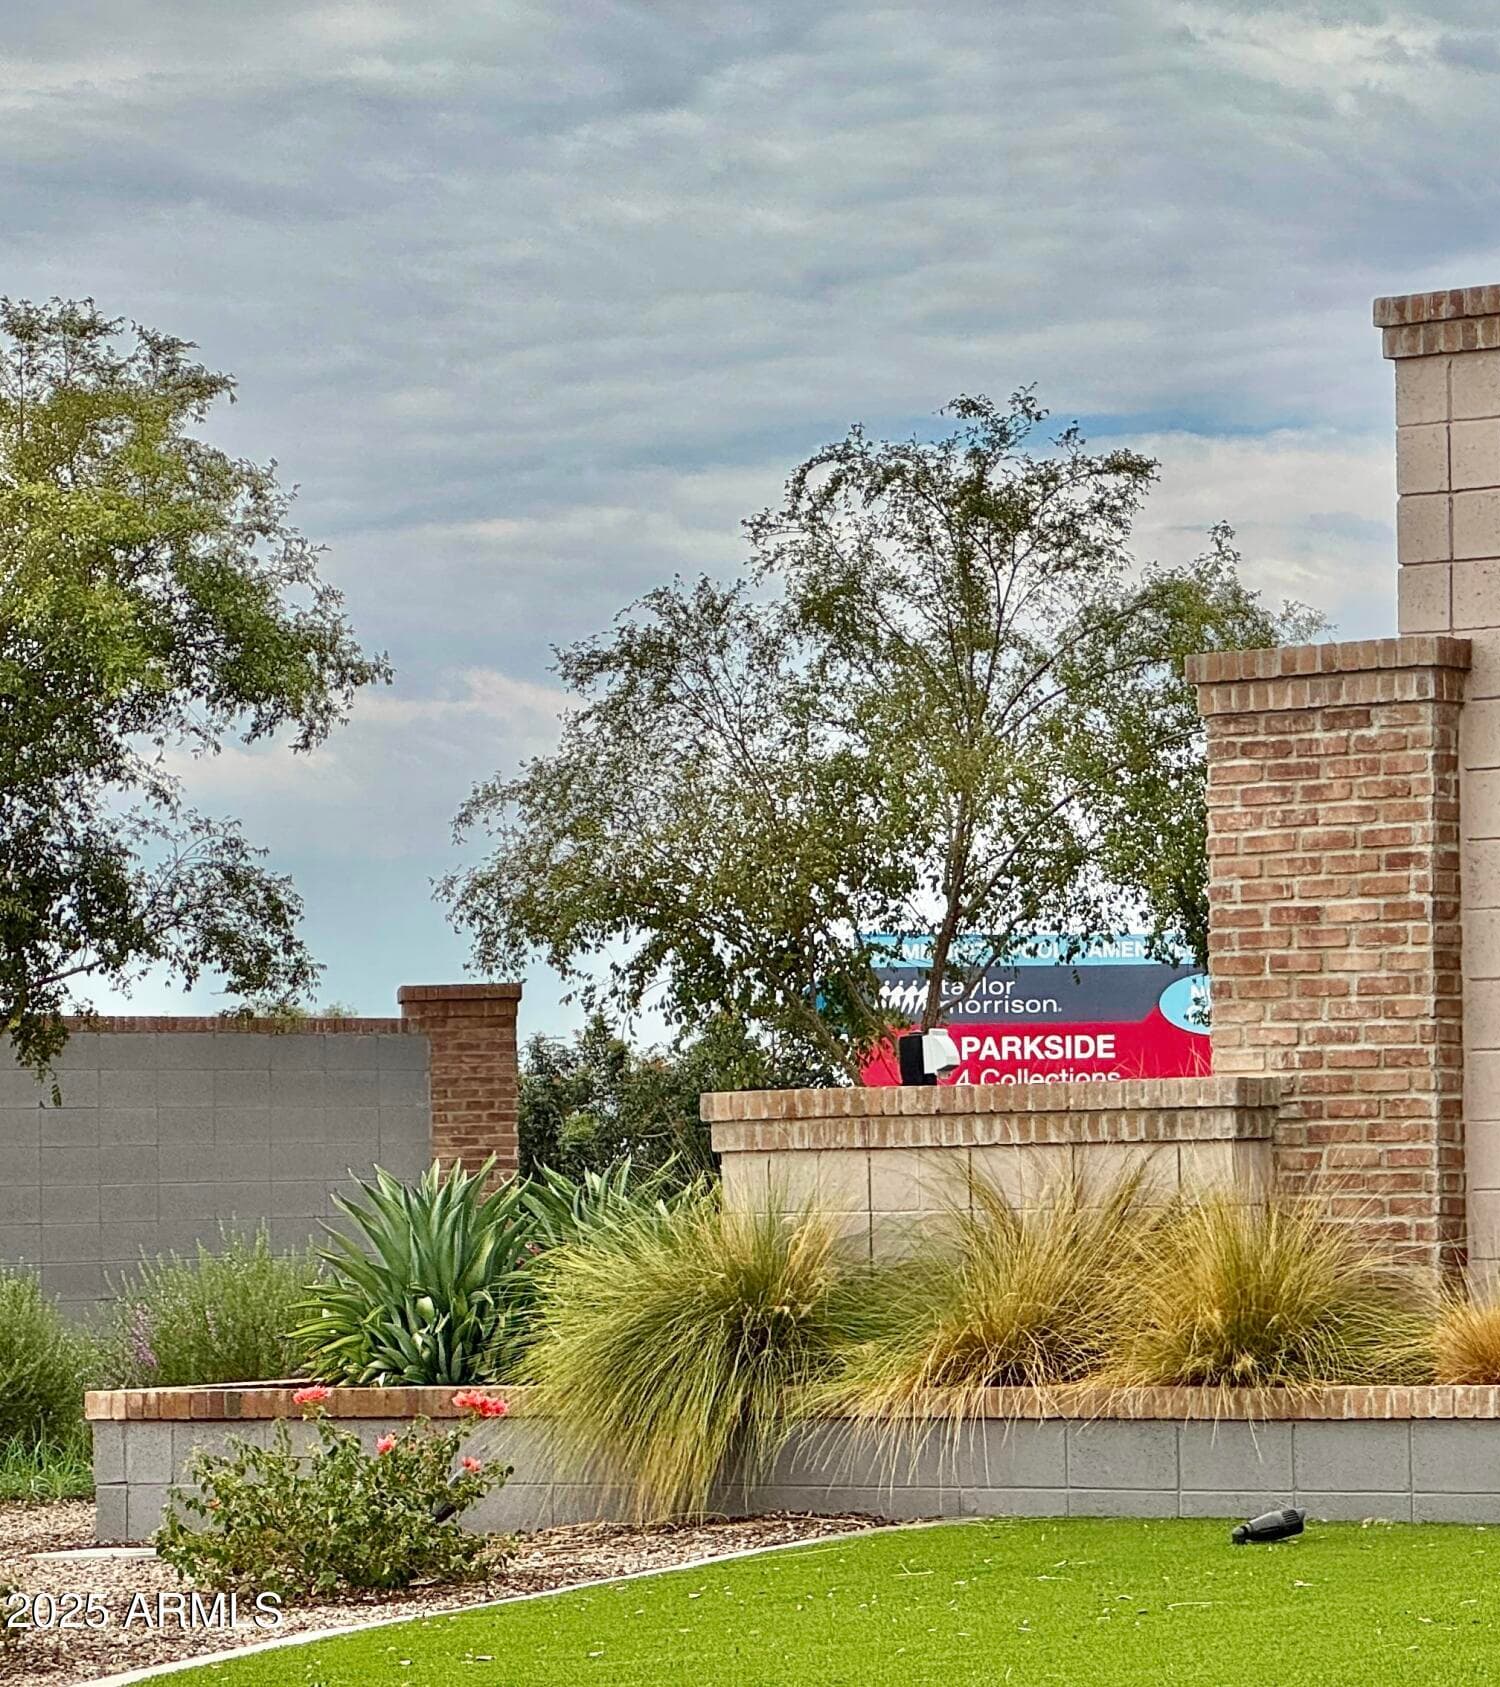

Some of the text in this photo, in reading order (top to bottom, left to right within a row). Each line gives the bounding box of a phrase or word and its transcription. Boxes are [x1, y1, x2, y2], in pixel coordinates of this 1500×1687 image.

[941, 976, 1016, 999] taylor
[961, 1034, 1116, 1061] PARKSIDE
[955, 1068, 971, 1086] 4
